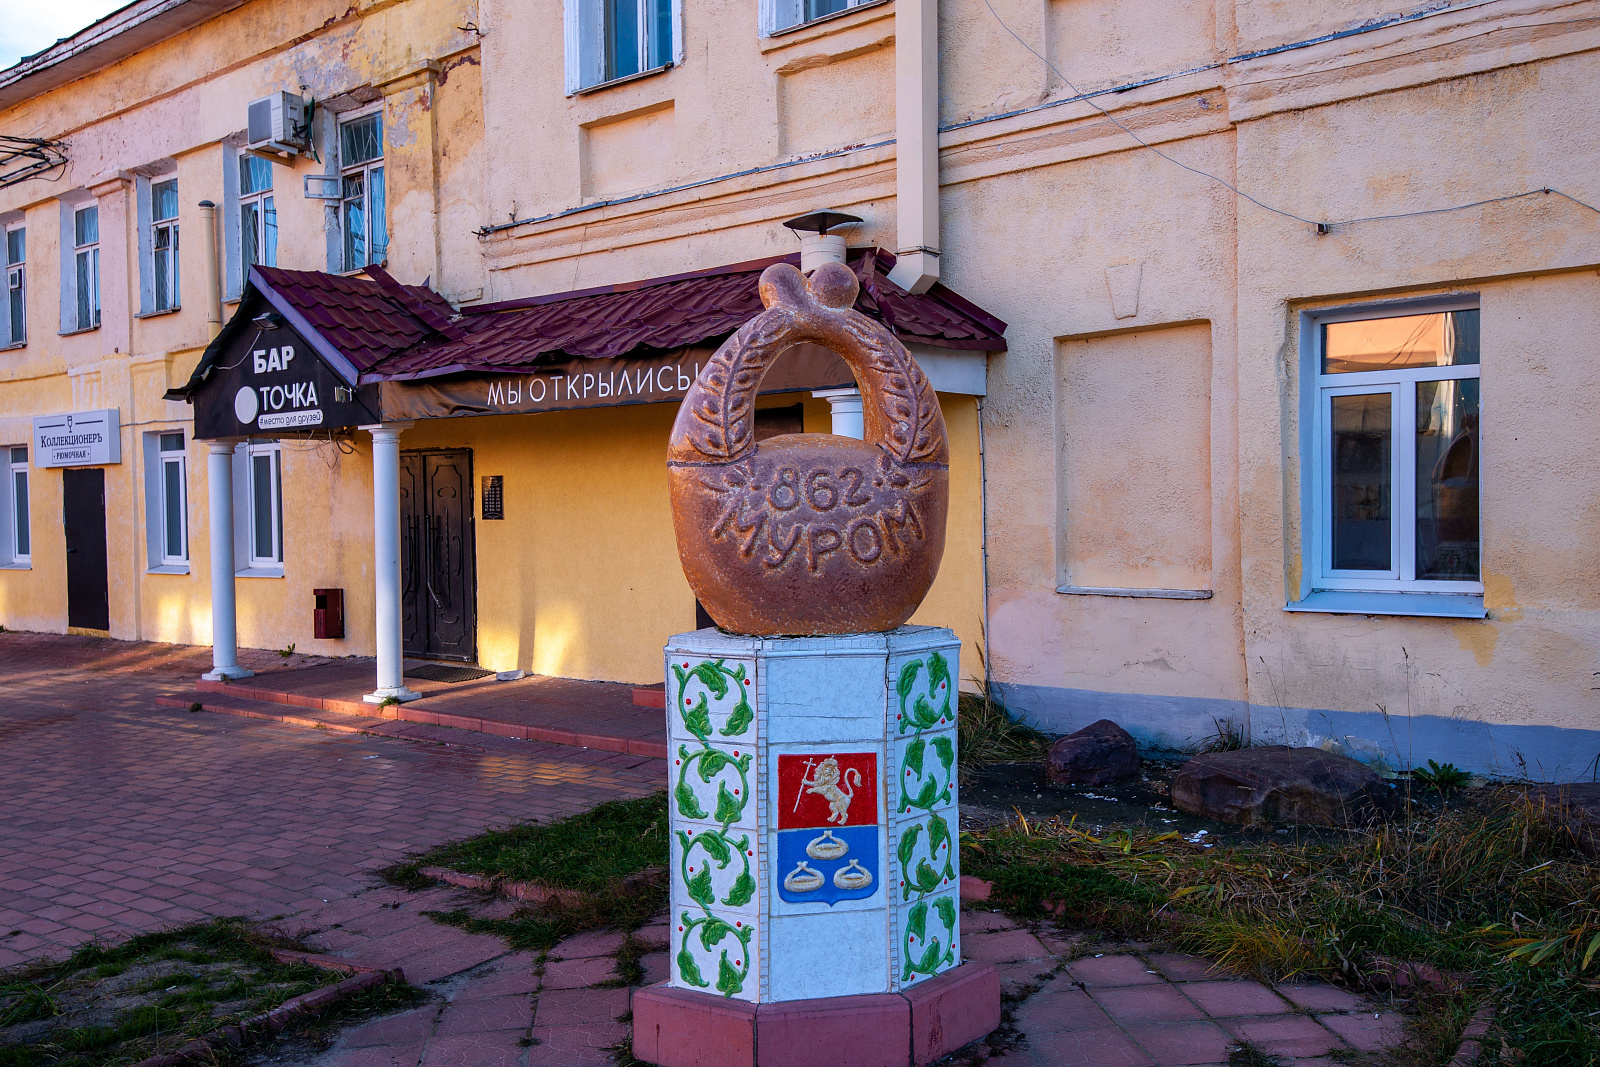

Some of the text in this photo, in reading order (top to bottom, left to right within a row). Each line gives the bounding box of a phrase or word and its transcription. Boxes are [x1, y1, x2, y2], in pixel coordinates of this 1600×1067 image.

[253, 345, 295, 374] БАР
[259, 381, 319, 412] ТОЧКА
[487, 380, 521, 406] МЫ
[259, 411, 320, 425] #место для друзей
[56, 450, 86, 460] РЮМОЧНАЯ
[767, 466, 872, 512] 862
[710, 498, 926, 573] МУРОМ
